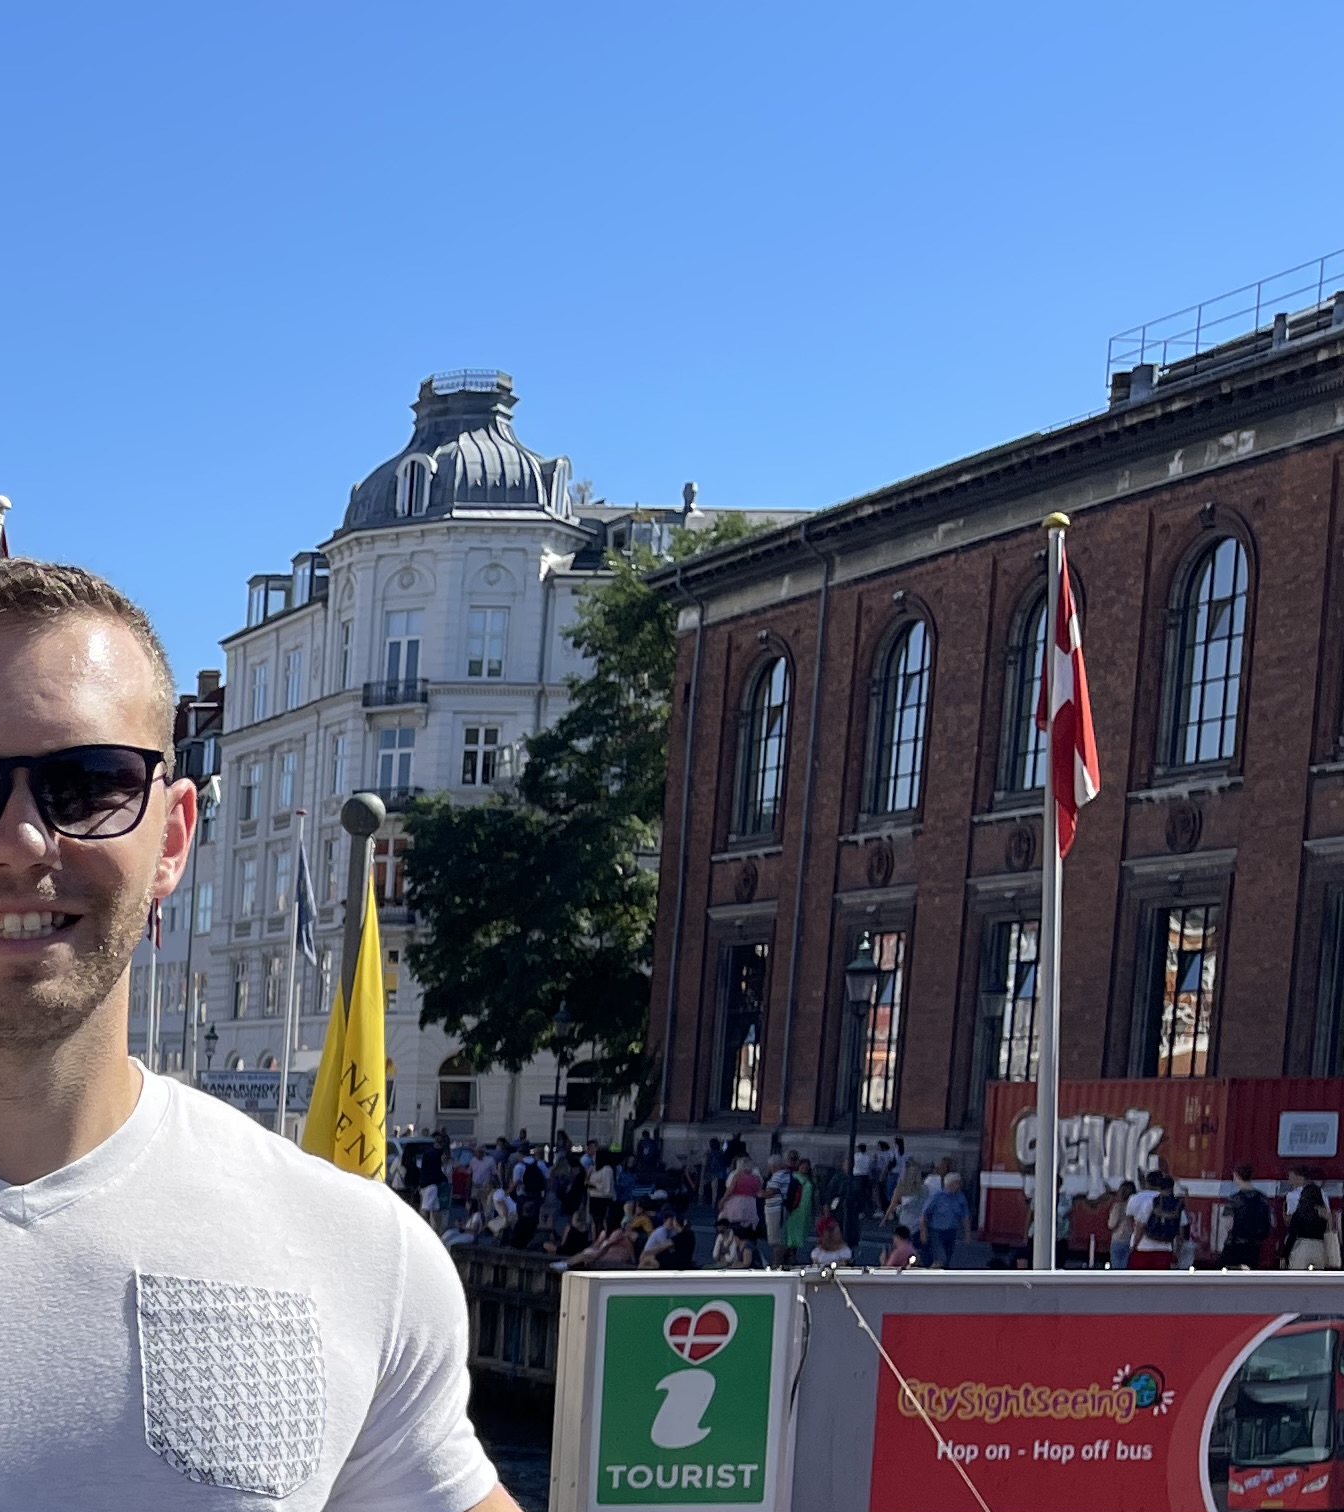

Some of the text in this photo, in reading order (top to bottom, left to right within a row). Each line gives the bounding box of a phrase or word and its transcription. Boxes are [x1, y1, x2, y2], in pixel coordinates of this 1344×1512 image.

[937, 1440, 978, 1464] Hop
[985, 1443, 1010, 1460] on
[1033, 1439, 1075, 1464] Hop
[1081, 1439, 1110, 1460] off
[1116, 1440, 1153, 1461] bus
[605, 1463, 759, 1490] TOURIST
